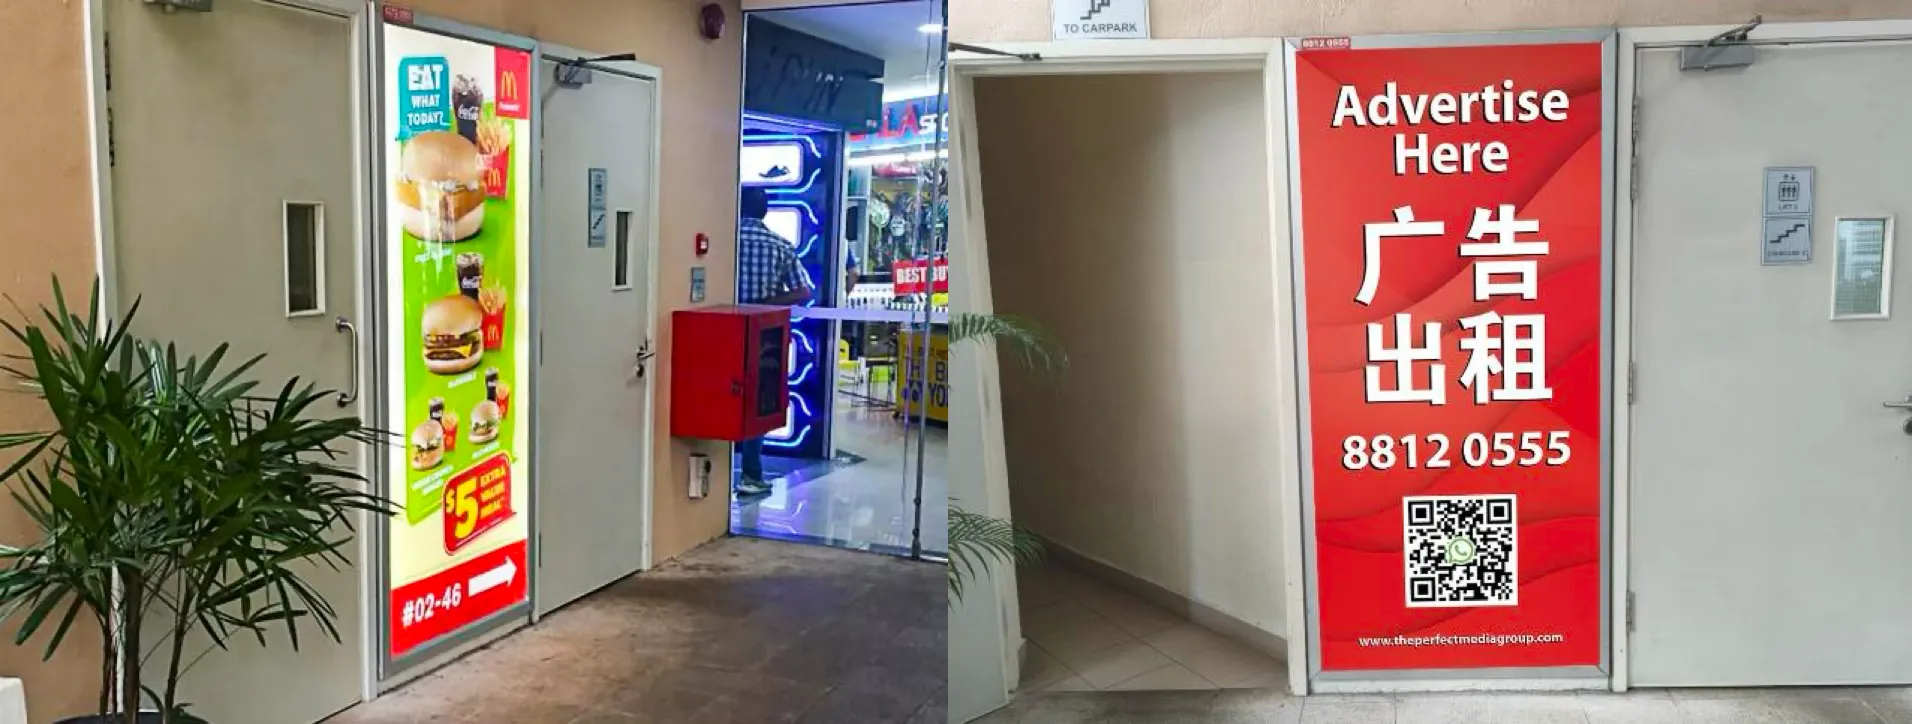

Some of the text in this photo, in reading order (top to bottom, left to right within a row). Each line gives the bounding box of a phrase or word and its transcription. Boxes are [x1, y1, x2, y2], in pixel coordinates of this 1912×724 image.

[1063, 22, 1138, 34] TO CARPARK
[408, 64, 443, 91] EAT
[407, 111, 444, 126] TODAY?
[411, 94, 441, 108] WHAT
[1331, 80, 1570, 126] Advertise
[1394, 133, 1510, 175] Here
[1354, 204, 1549, 305] 广告
[896, 266, 928, 284] BEST
[1364, 310, 1553, 405] 出租
[1341, 430, 1572, 470] 8812 0555
[445, 477, 479, 539] $5
[402, 582, 462, 629] #02-46
[1358, 632, 1564, 648] www.theperfectmediagroup.com
